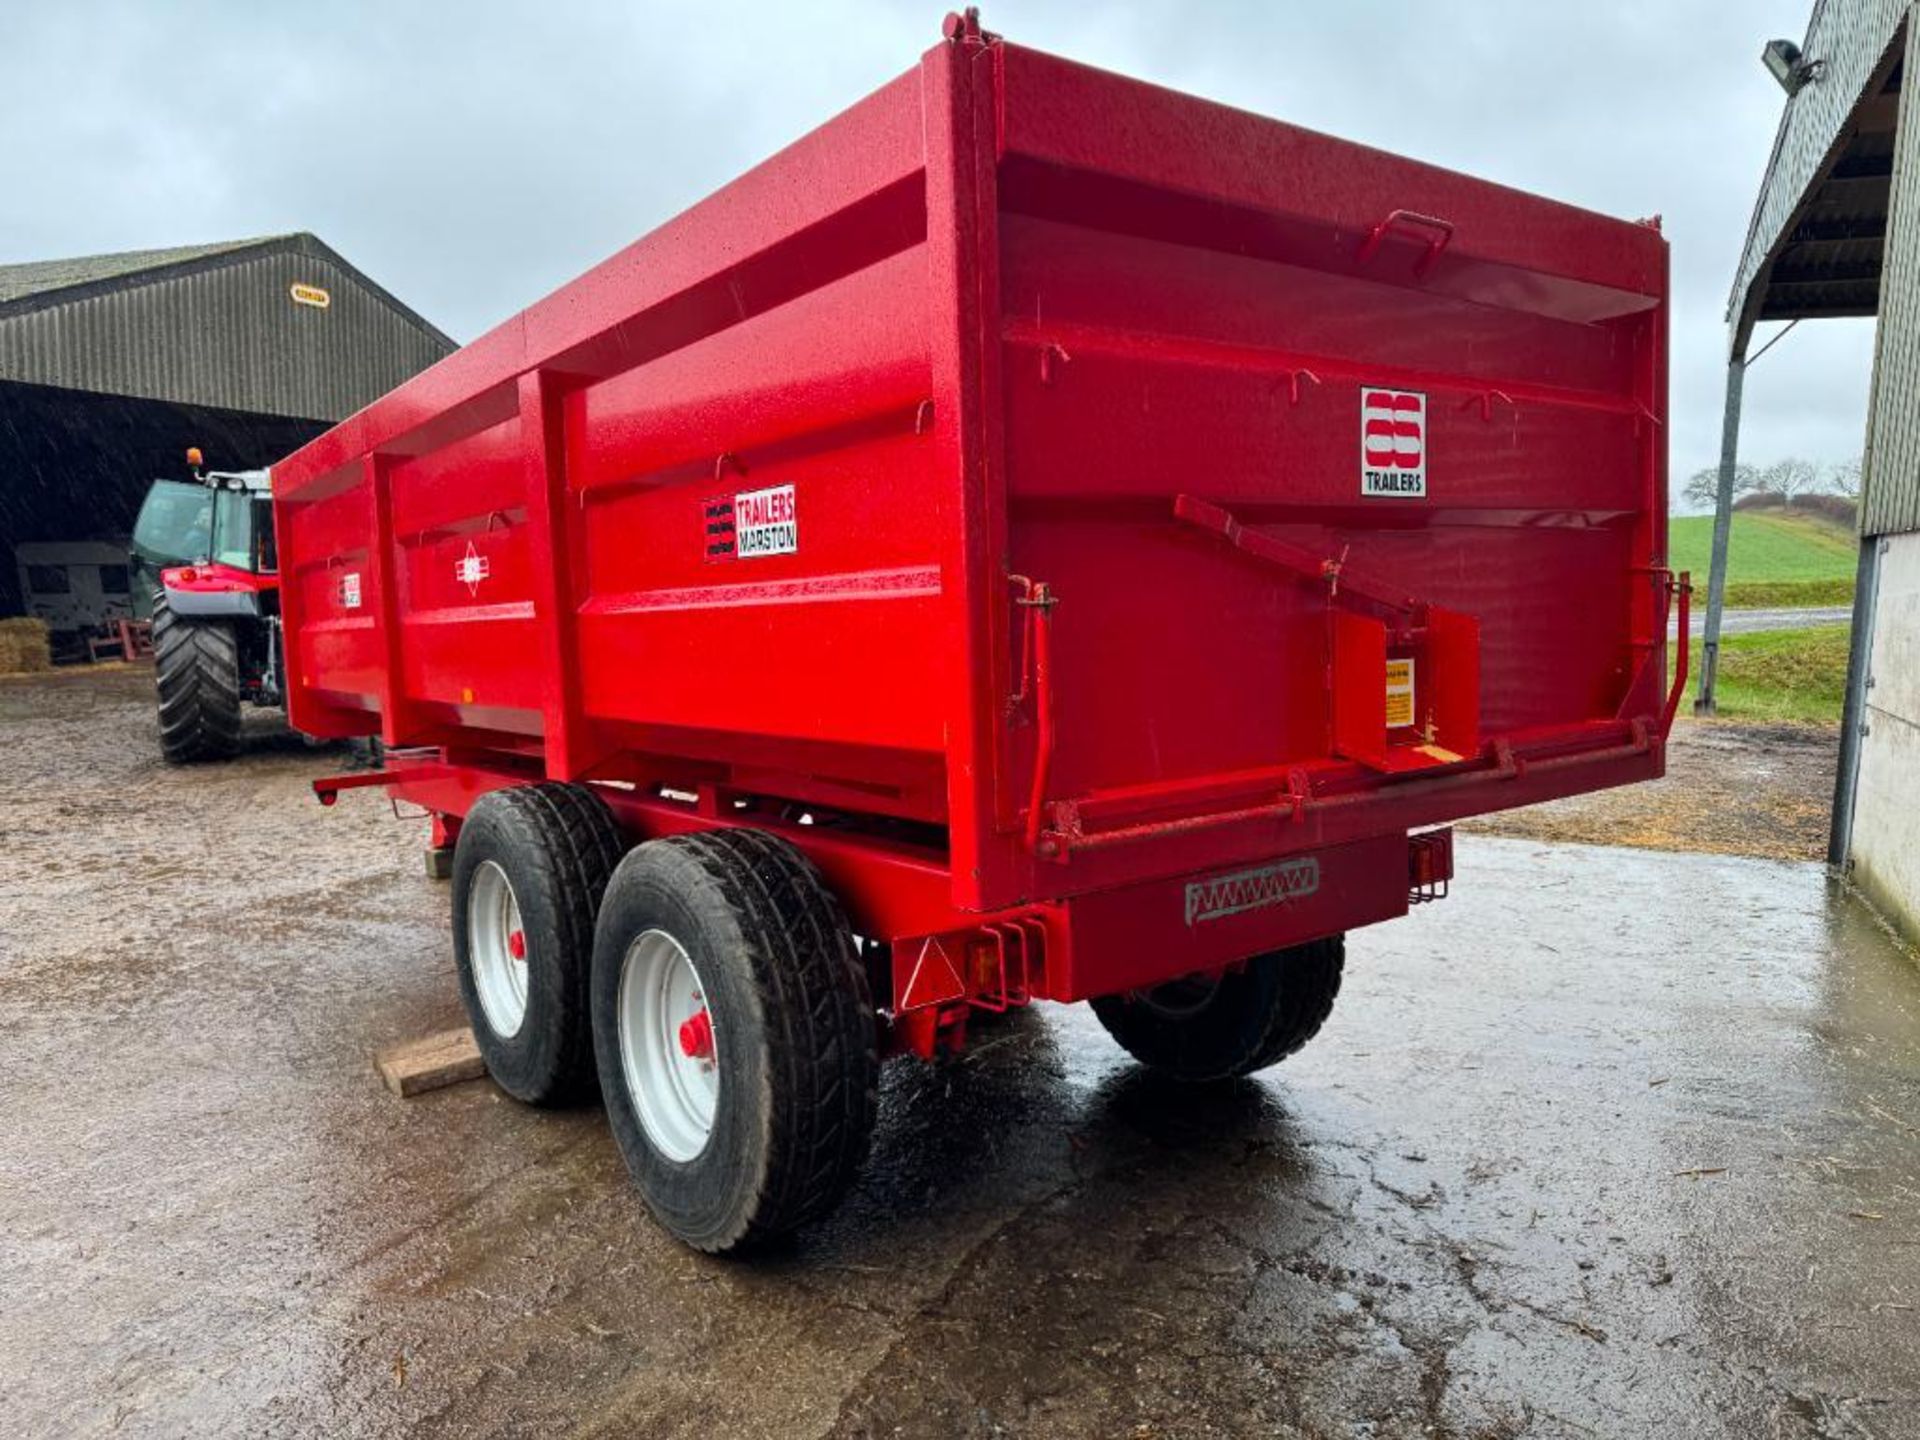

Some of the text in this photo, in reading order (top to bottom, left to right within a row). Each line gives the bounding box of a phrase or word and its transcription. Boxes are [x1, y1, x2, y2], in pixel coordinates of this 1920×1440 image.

[1365, 471, 1422, 492] TRAILERS
[738, 491, 793, 528] TRAILERS
[739, 524, 794, 552] MARSTON
